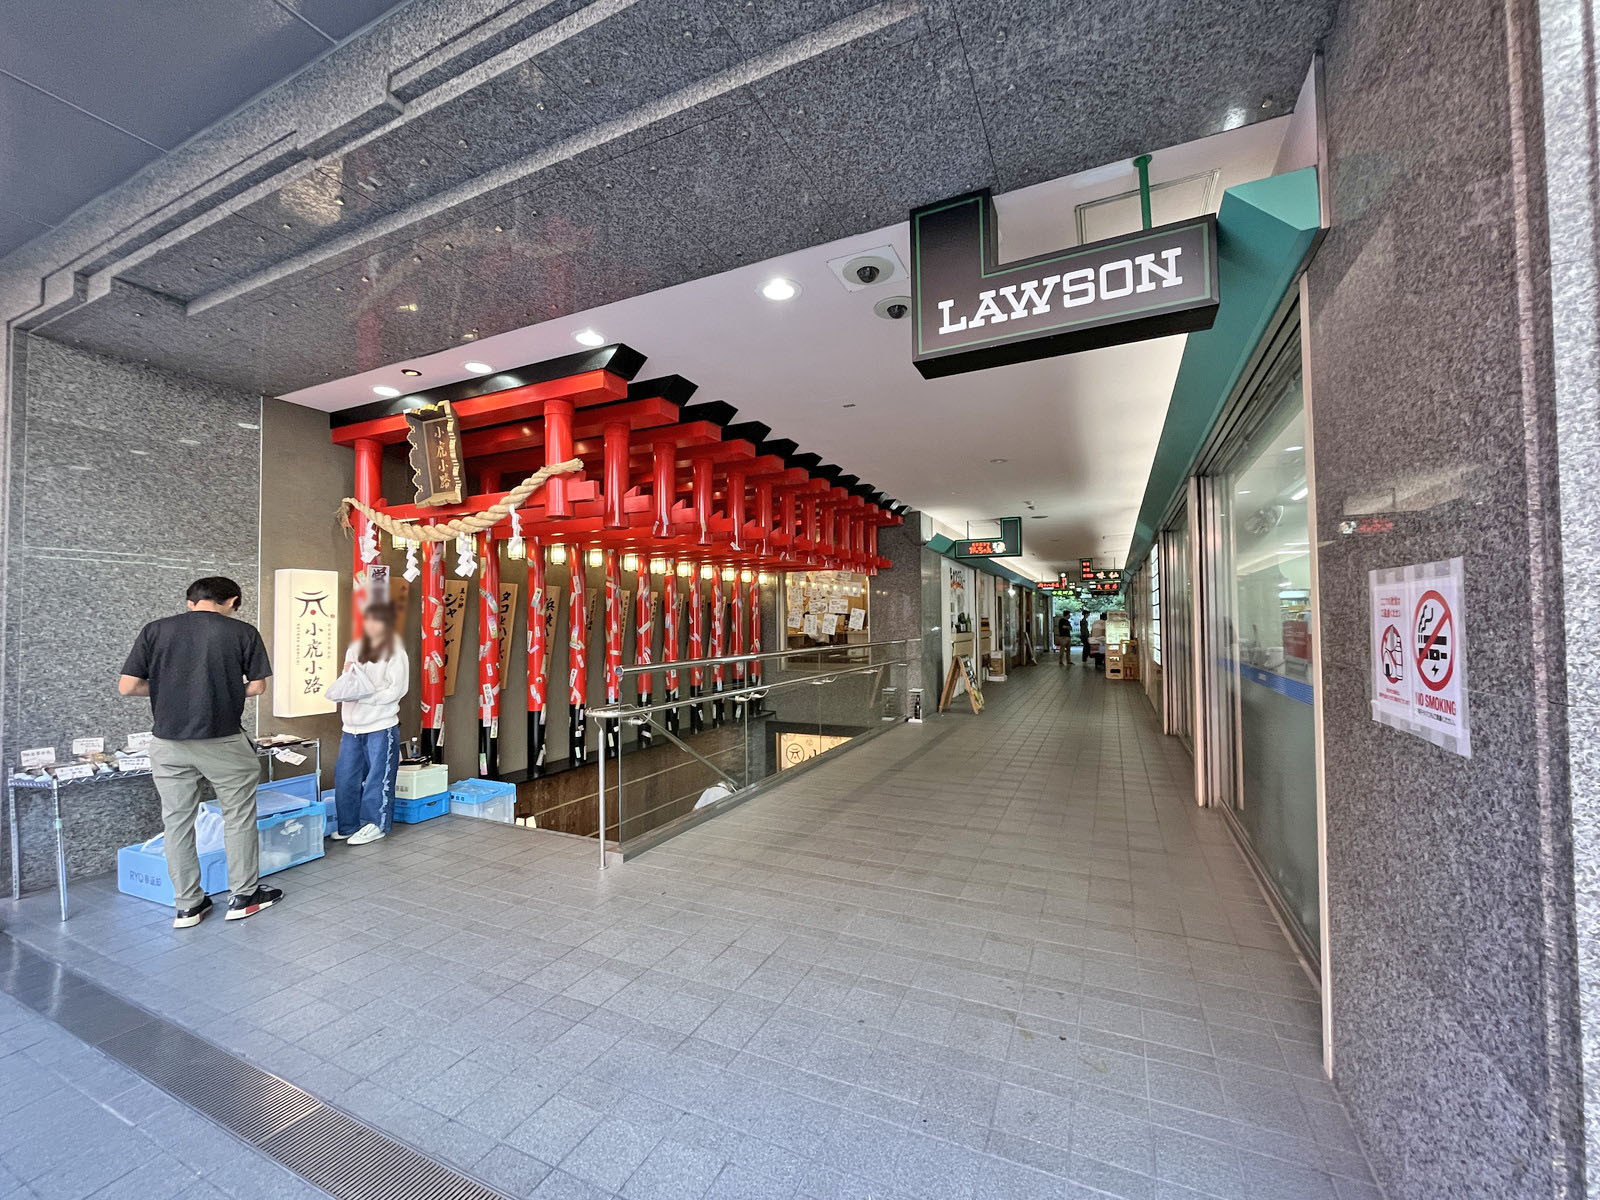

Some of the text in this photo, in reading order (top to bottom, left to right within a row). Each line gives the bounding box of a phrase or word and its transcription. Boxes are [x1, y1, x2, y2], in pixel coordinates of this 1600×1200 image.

[937, 247, 1183, 335] LAWSON
[434, 426, 451, 489] 小虎小路
[303, 622, 324, 695] 小虎小路
[1415, 691, 1424, 707] NO
[1425, 695, 1457, 716] SMOKING
